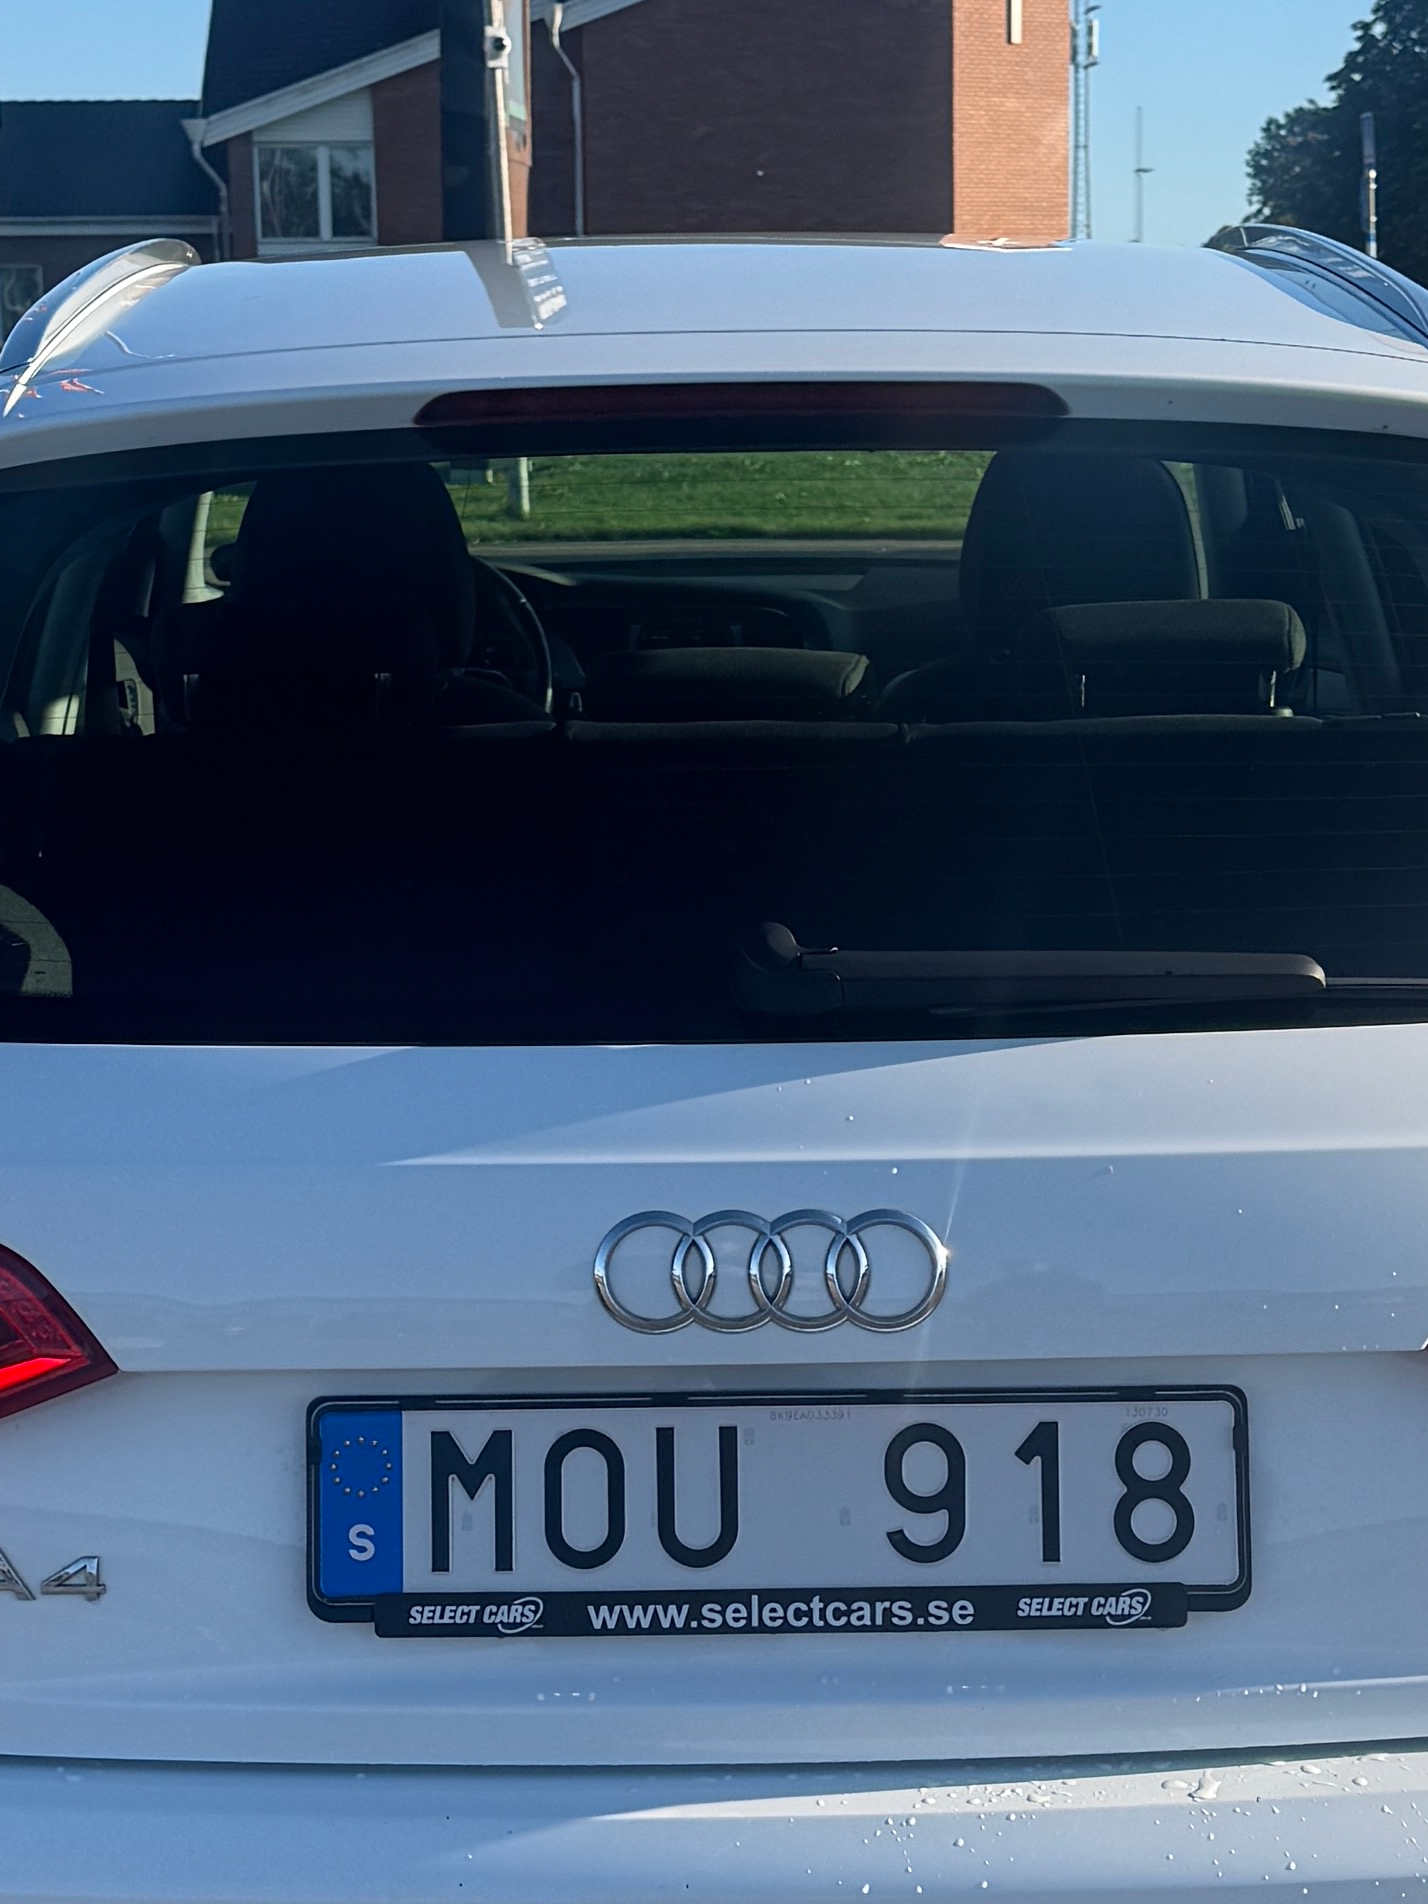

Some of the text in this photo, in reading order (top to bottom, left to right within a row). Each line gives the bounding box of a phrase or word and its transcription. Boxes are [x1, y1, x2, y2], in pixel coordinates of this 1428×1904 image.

[1126, 1406, 1169, 1418] 130730
[348, 1420, 1196, 1573] S MOU 918
[408, 1604, 536, 1625] SELECT CARS
[586, 1594, 976, 1630] www.selectcars.se
[1016, 1596, 1145, 1617] SELECT CARS
